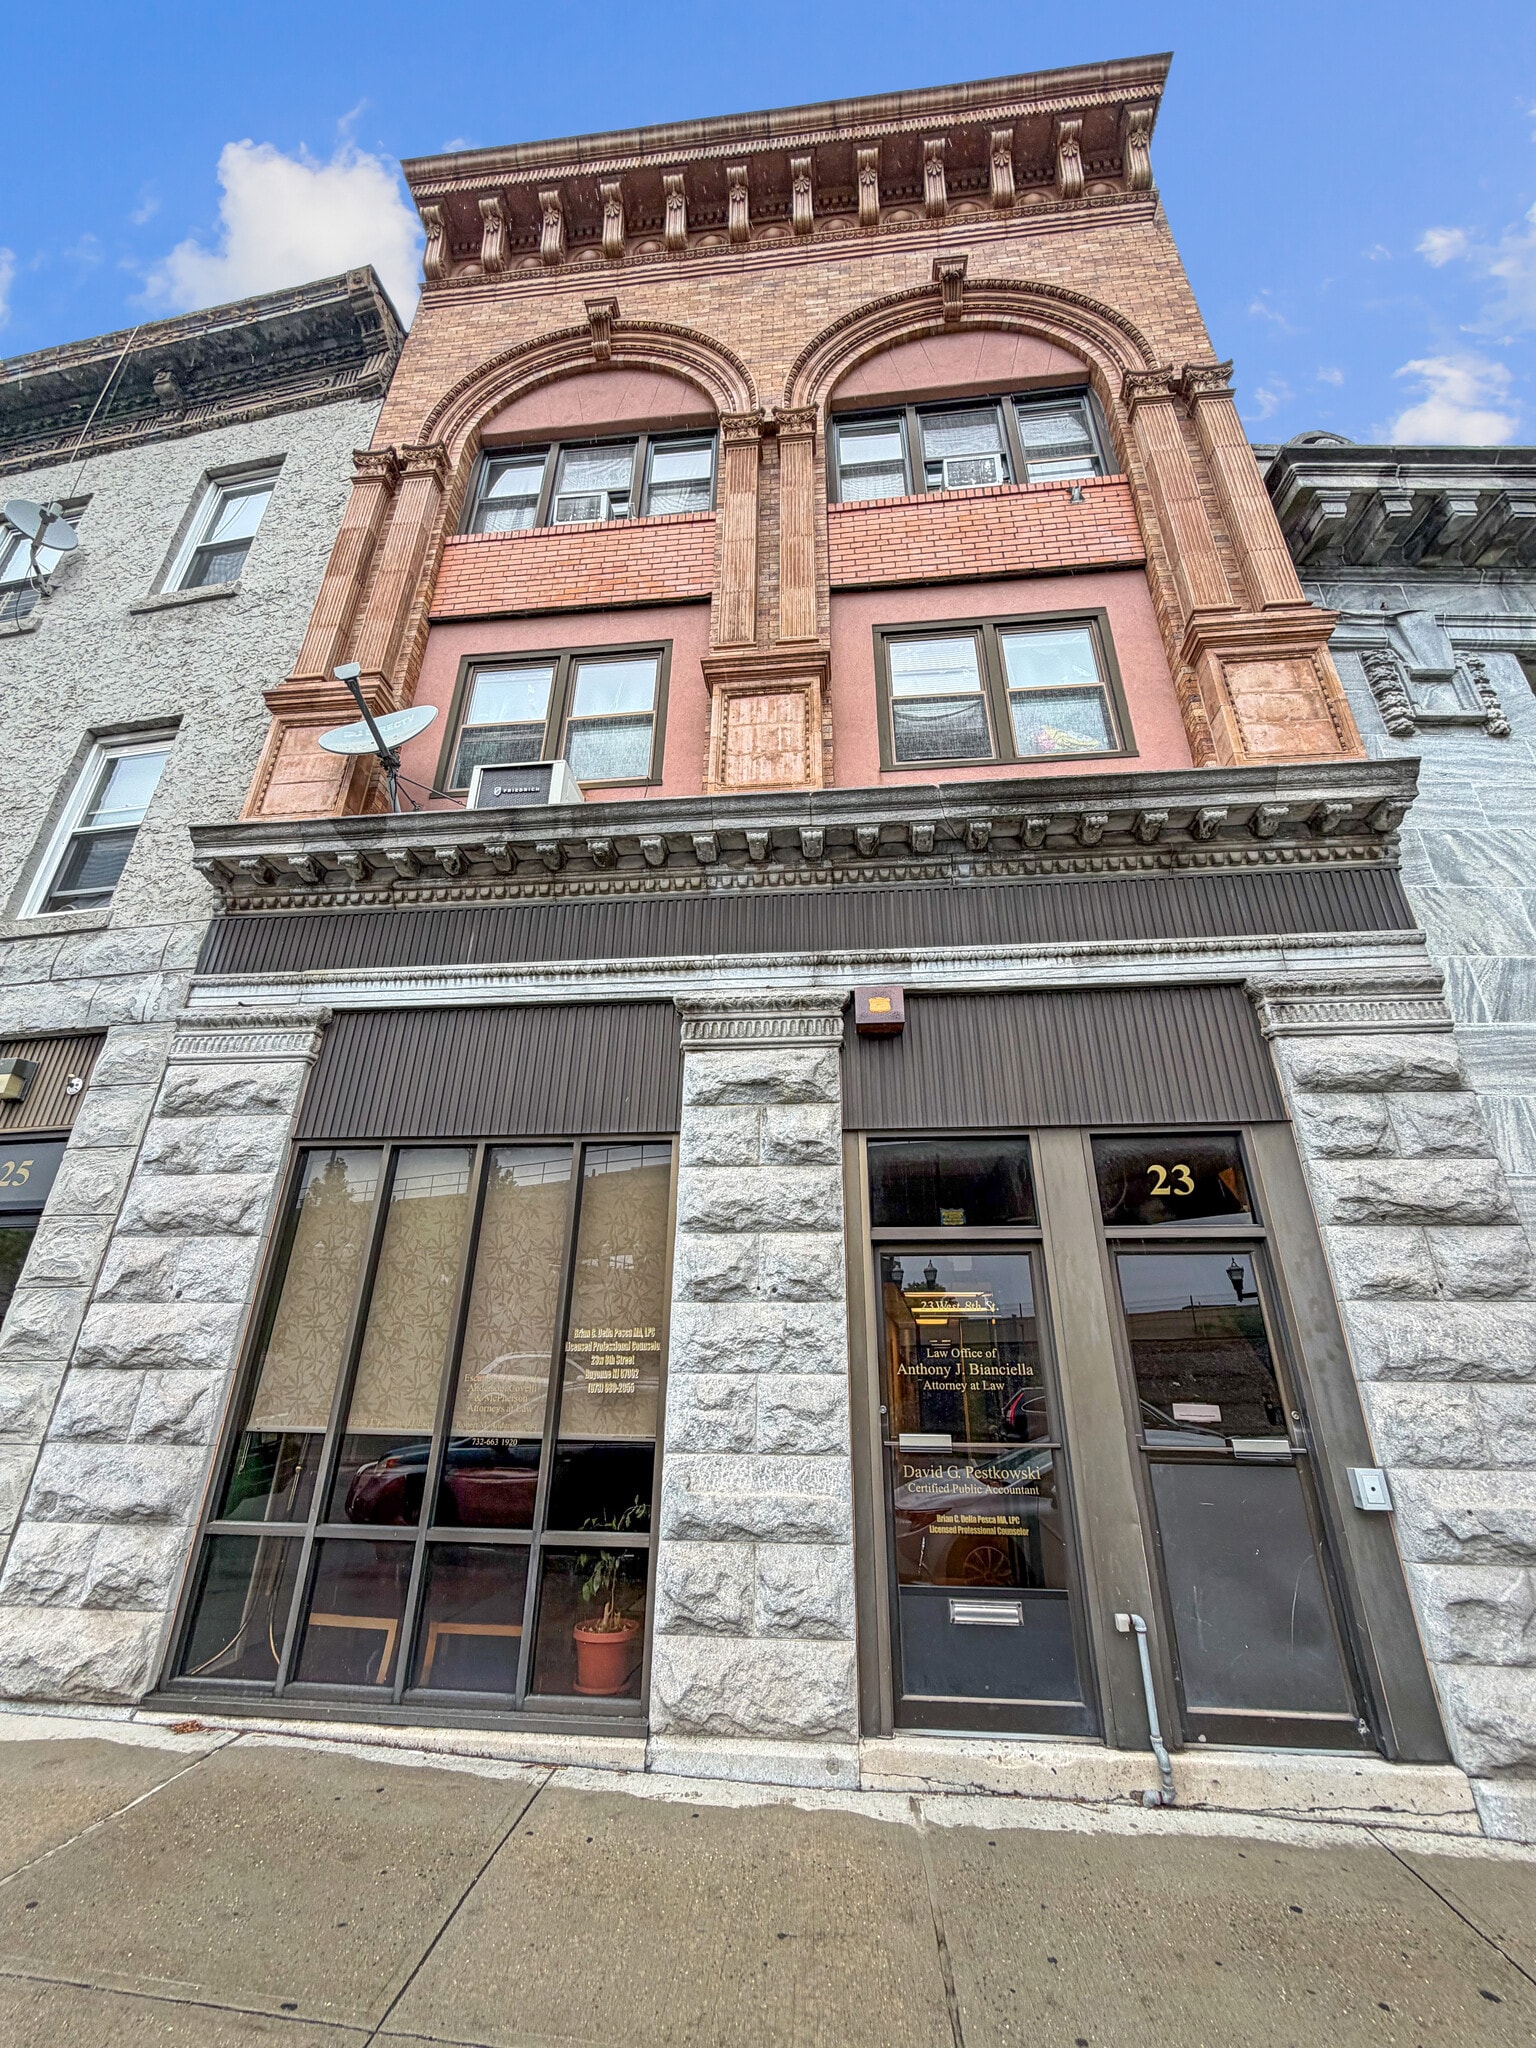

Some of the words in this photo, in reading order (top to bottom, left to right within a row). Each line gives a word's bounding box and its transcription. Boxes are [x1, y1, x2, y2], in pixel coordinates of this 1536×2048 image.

[0, 1160, 34, 1187] 25
[1146, 1163, 1195, 1196] 23
[920, 1301, 933, 1310] 23
[935, 1301, 960, 1310] West
[964, 1300, 981, 1310] 8th
[986, 1300, 1000, 1311] St.
[926, 1348, 948, 1358] Law
[951, 1348, 983, 1358] Office
[985, 1348, 998, 1358] of
[897, 1363, 951, 1378] Anthony
[955, 1363, 965, 1376] J.
[969, 1363, 1034, 1376] Bianciella
[923, 1380, 967, 1392] Attorney
[970, 1382, 980, 1390] at
[982, 1381, 1005, 1390] Law
[468, 1405, 505, 1415] Attorneys
[501, 1438, 518, 1446] 1920
[903, 1465, 943, 1479] David
[947, 1465, 961, 1479] G.
[965, 1465, 1041, 1480] Pestkowski
[908, 1483, 950, 1493] Certified
[952, 1484, 983, 1494] Public
[985, 1485, 1040, 1495] Accountant
[936, 1514, 954, 1523] Brian
[954, 1514, 960, 1523] C.
[961, 1515, 977, 1524] Della
[977, 1515, 996, 1524] Pesca
[997, 1516, 1008, 1525] MA,
[1008, 1516, 1020, 1525] LPC
[929, 1525, 957, 1534] Licensed
[957, 1526, 996, 1535] Professional
[997, 1527, 1029, 1536] Counselor
